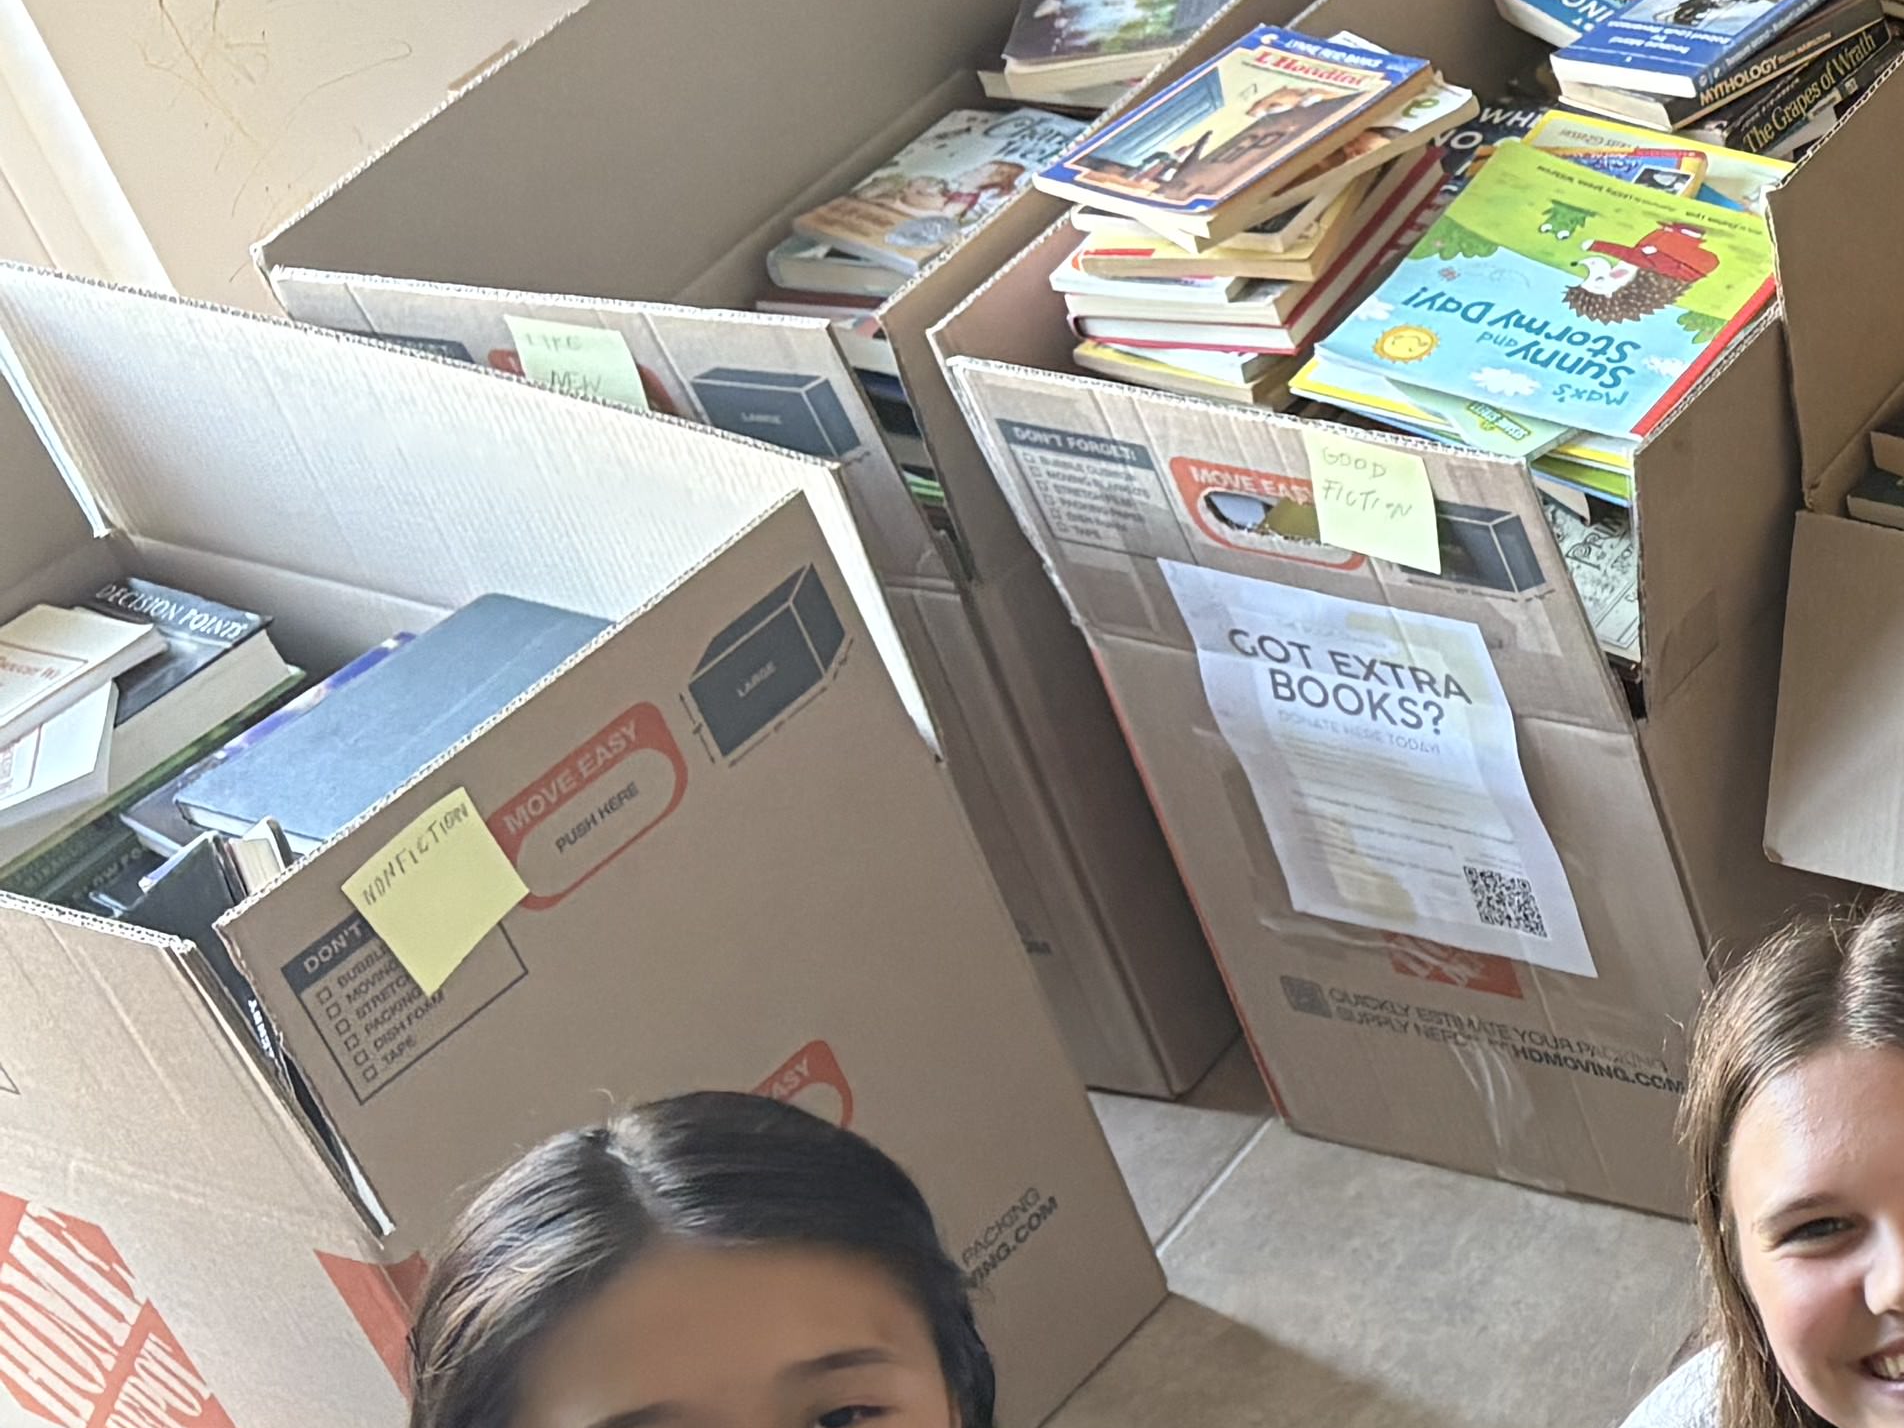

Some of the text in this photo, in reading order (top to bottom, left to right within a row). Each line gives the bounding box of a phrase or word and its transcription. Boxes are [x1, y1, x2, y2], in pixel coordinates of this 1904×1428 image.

[1699, 54, 1780, 106] MYTHOLOGY
[1742, 33, 1876, 155] The Grapes of Wrath
[1401, 286, 1641, 364] Stormy Day!
[1475, 330, 1636, 389] Sunny and
[1551, 383, 1629, 406] Max's
[1192, 466, 1258, 493] MOVE
[1320, 444, 1389, 481] GOOD
[96, 583, 249, 640] DECISION POINTS
[1228, 628, 1474, 705] GOT EXTRA
[1268, 668, 1446, 737] BOOKS?
[502, 718, 642, 835] MOVE EASY
[554, 781, 640, 855] PUSH HERE
[362, 802, 470, 907] NONFICTION
[303, 920, 362, 975] DON'T
[381, 1033, 418, 1066] TAPE
[959, 1185, 1041, 1267] PACKING
